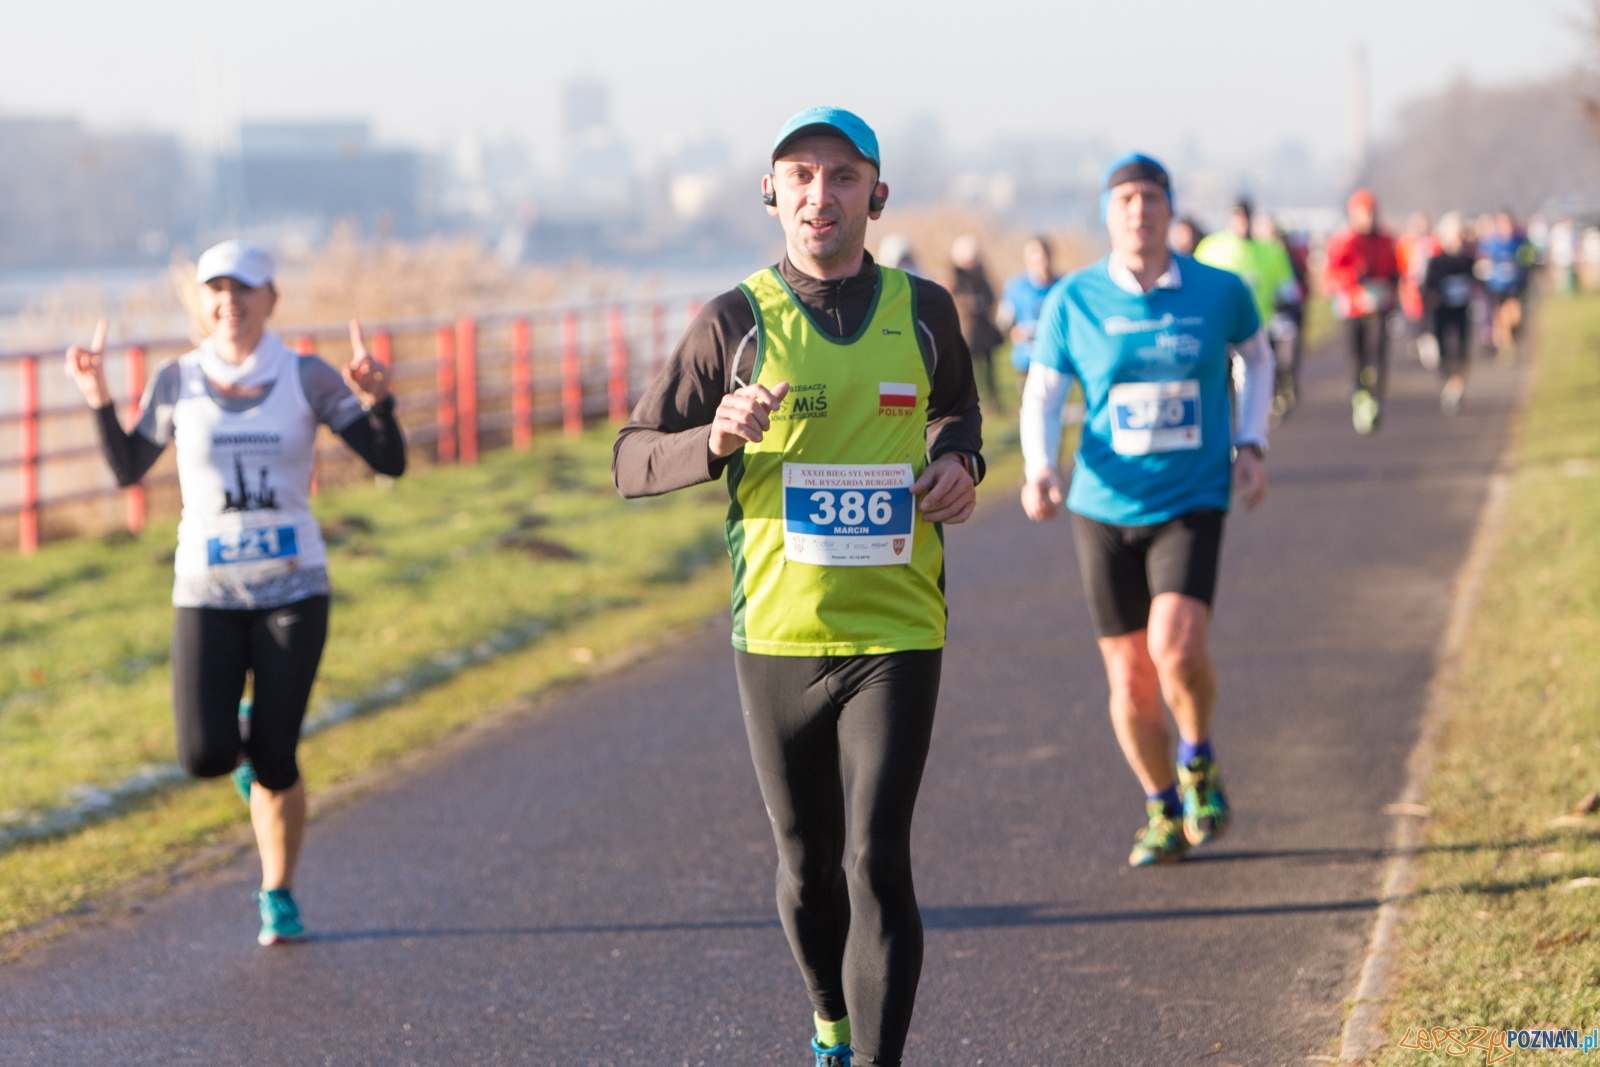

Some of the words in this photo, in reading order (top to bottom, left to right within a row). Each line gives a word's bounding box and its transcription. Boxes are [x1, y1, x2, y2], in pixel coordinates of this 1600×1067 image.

[801, 469, 824, 477] XXXII
[848, 469, 906, 477] SYLWESTROWY
[819, 479, 863, 487] RYSZARDA
[865, 478, 904, 486] BURGIELA
[809, 490, 893, 526] 386
[833, 526, 870, 535] MARCIN
[219, 527, 281, 560] 321
